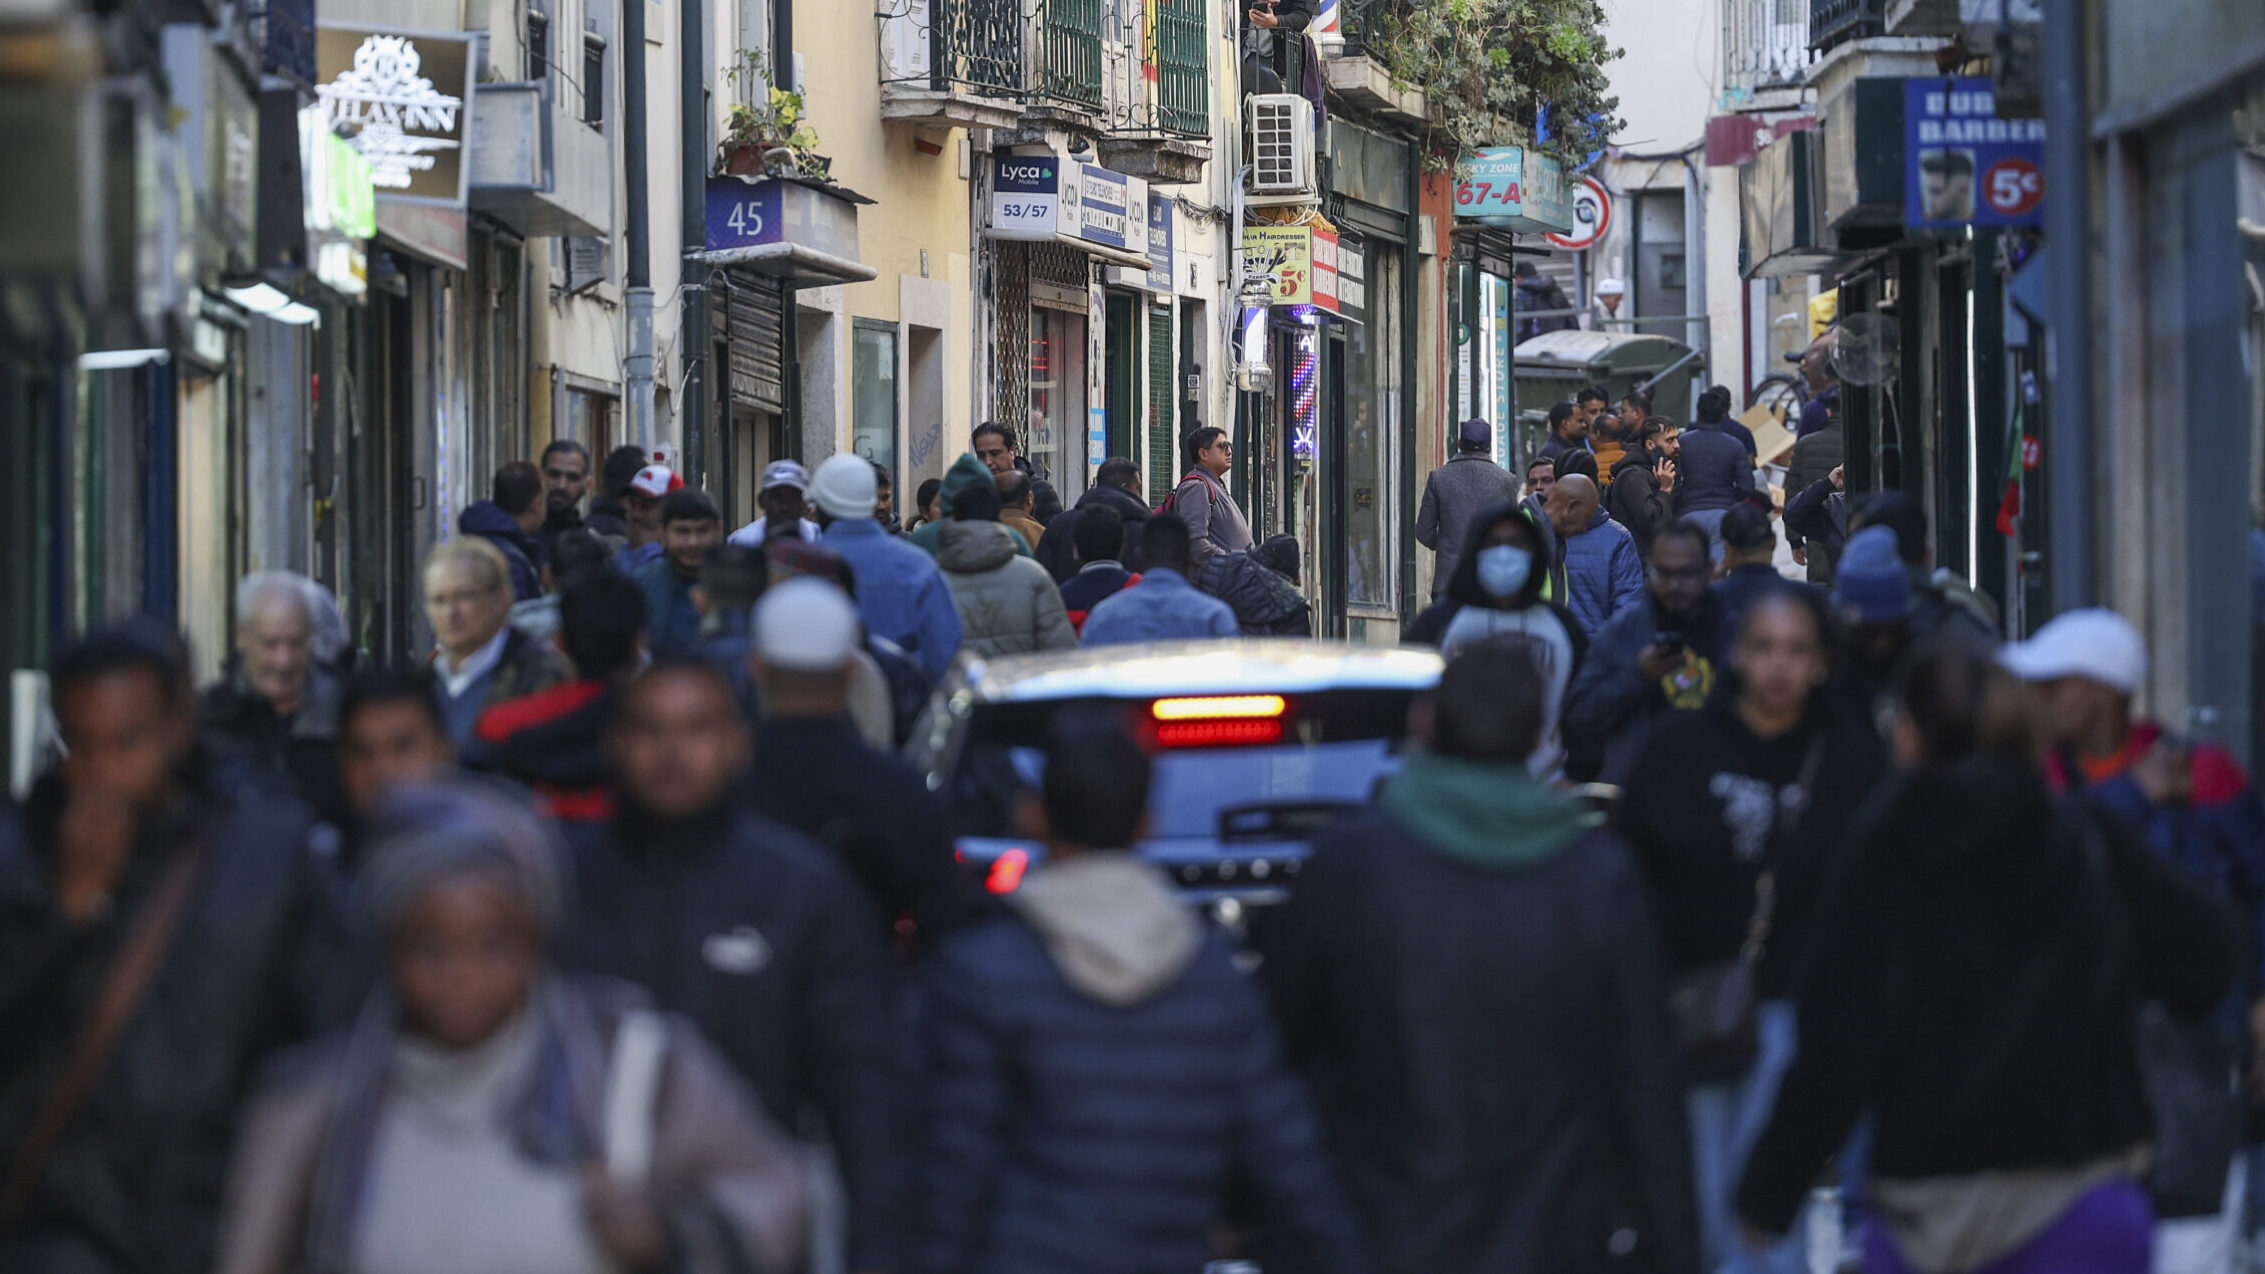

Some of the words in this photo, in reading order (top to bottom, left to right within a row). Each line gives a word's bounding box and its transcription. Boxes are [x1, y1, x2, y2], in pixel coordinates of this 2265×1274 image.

[1001, 163, 1040, 180] Lyca
[1489, 163, 1520, 173] ZONE
[1455, 181, 1521, 205] 67-A
[1992, 167, 2040, 209] 5€
[727, 202, 763, 236] 45
[1003, 202, 1048, 219] 53/57
[1280, 269, 1306, 297] 5€
